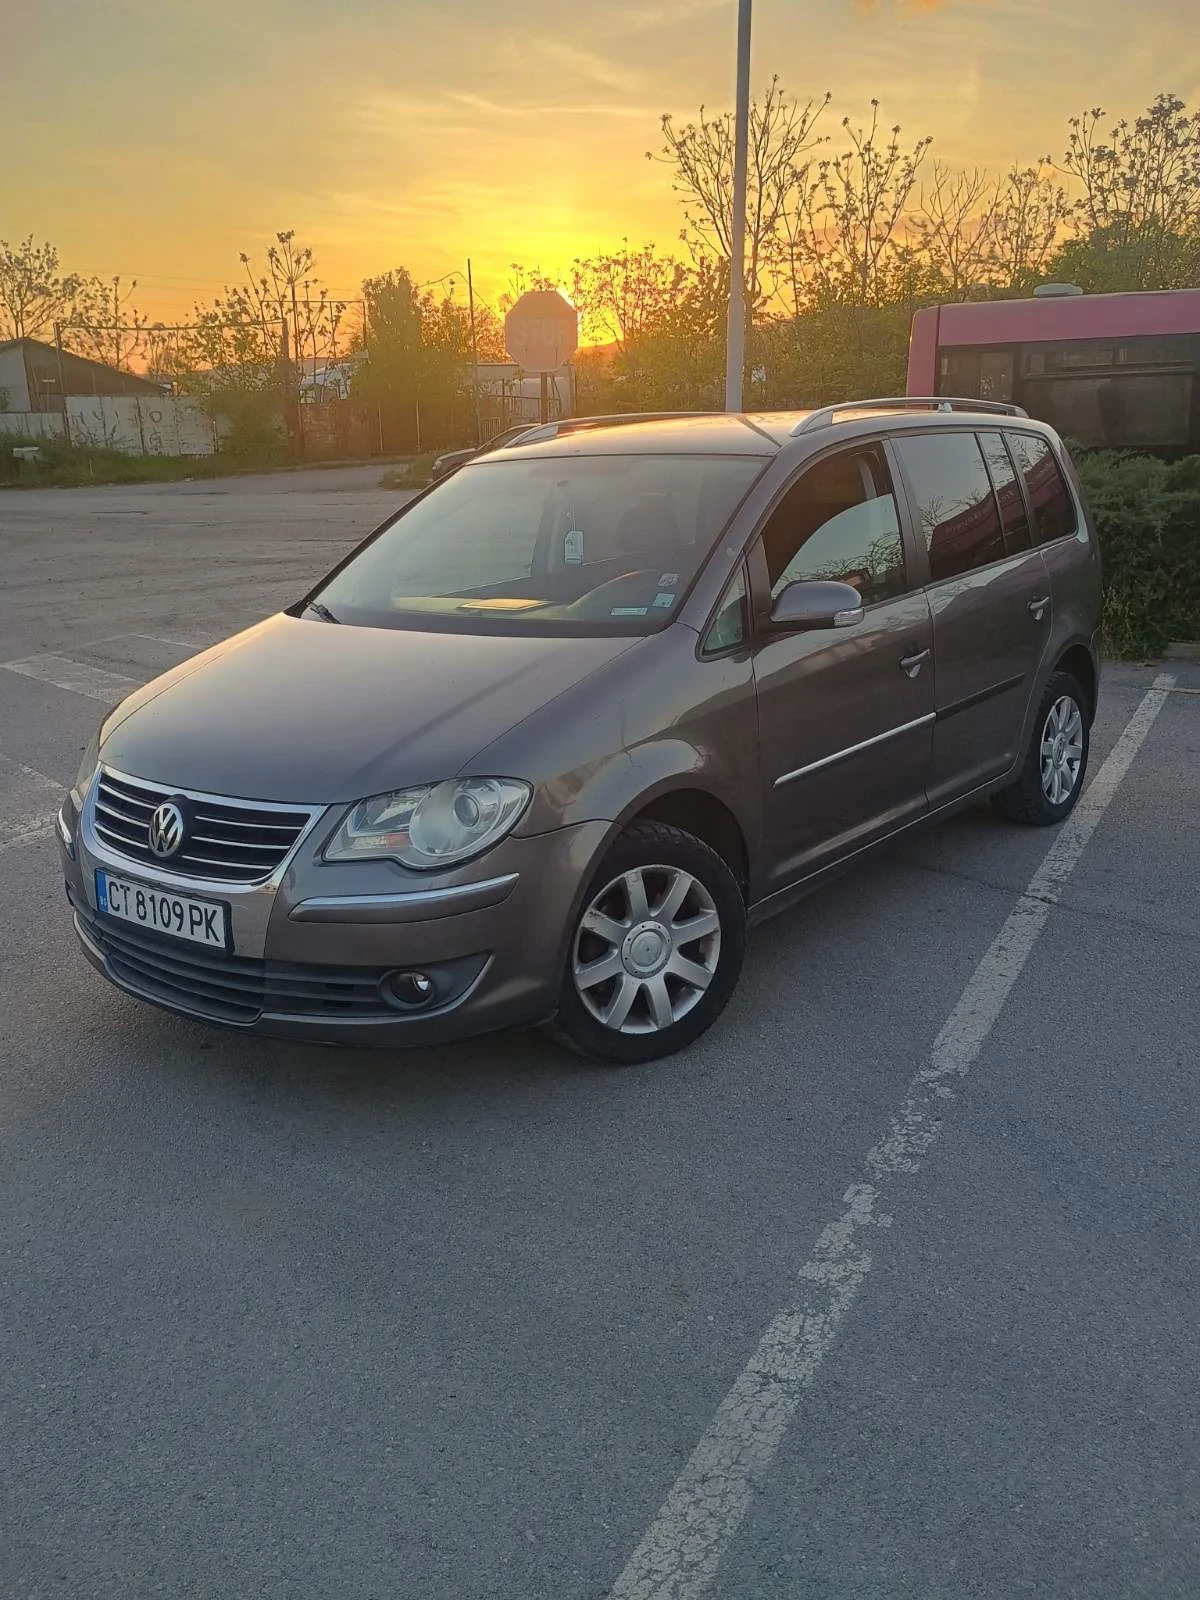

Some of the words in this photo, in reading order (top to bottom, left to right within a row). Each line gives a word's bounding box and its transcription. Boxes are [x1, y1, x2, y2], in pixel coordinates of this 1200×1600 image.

[108, 880, 130, 915] CT
[135, 890, 184, 932] 8109
[188, 903, 220, 942] PK
